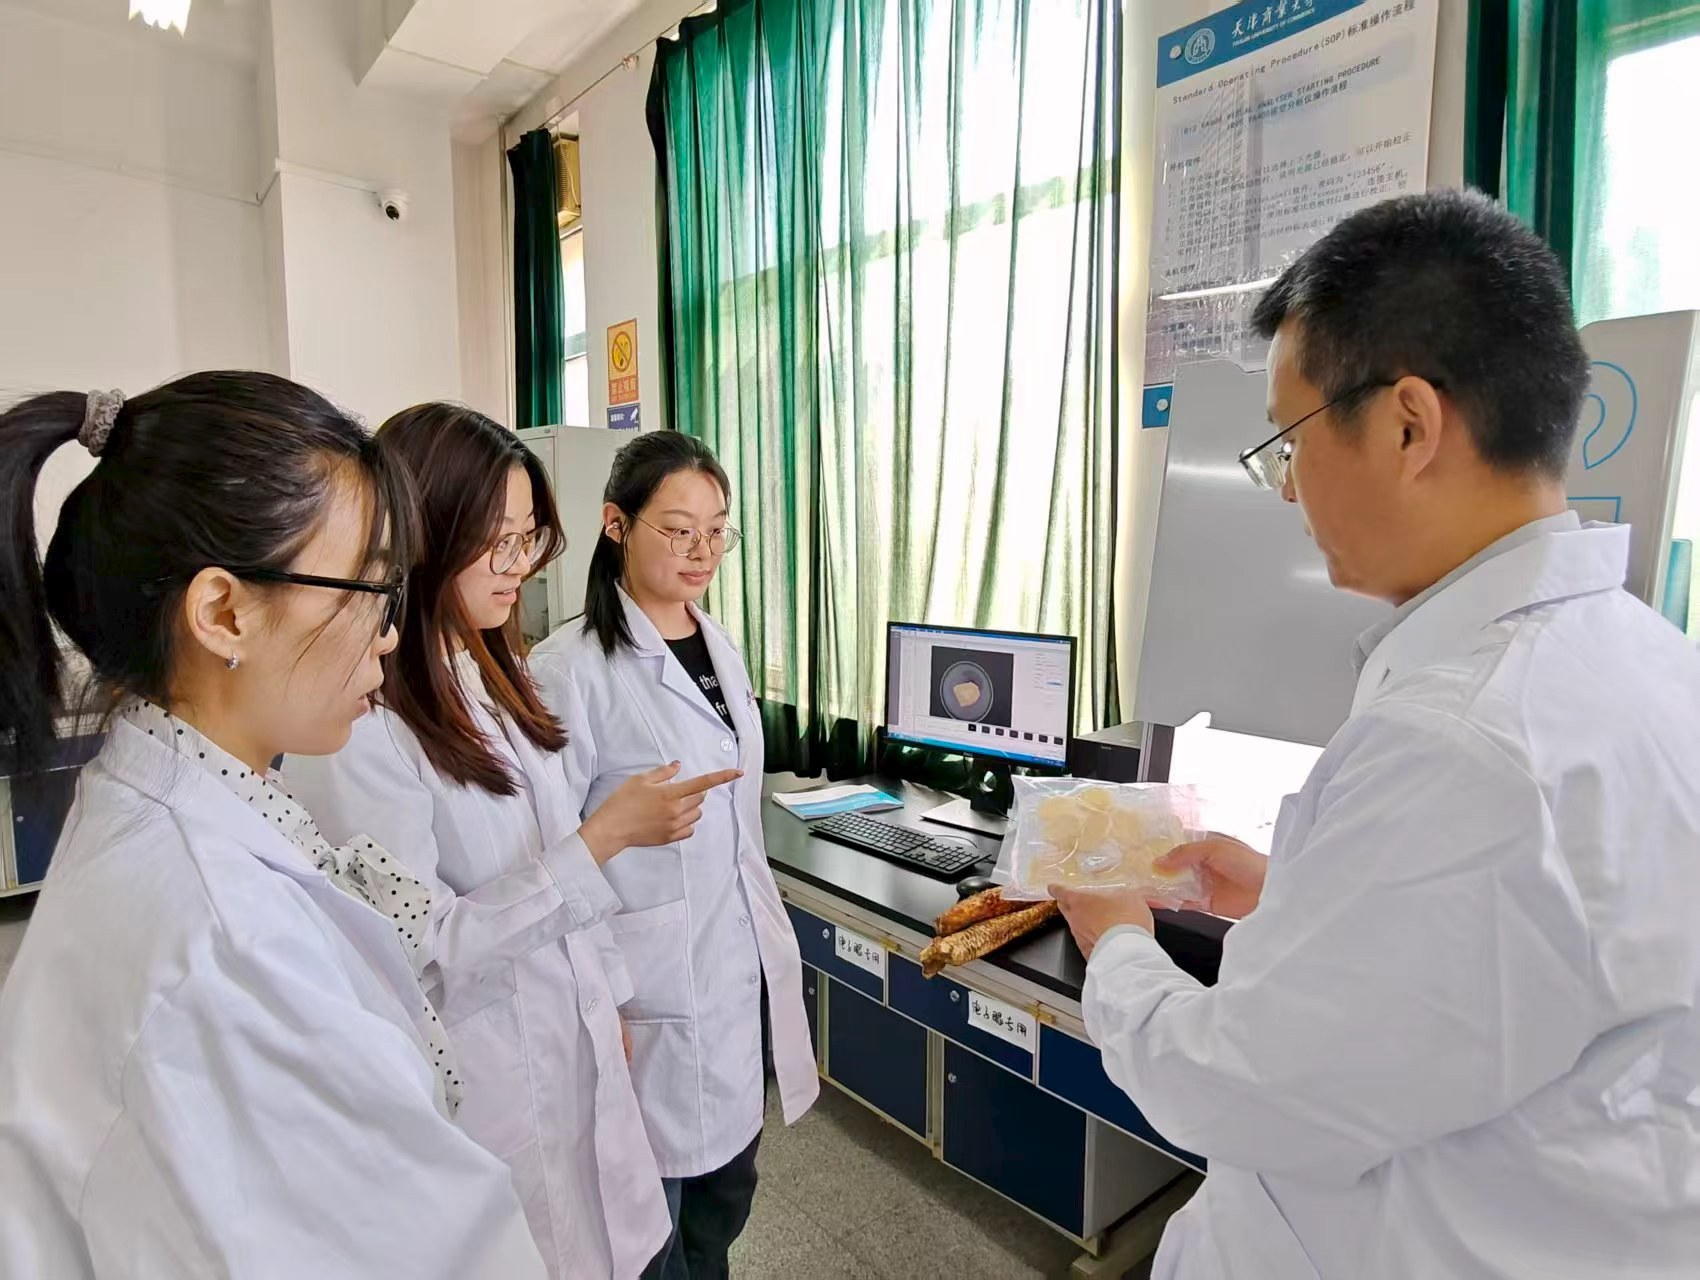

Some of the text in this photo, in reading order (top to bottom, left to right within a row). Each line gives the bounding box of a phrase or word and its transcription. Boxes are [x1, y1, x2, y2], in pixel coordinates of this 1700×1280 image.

[1173, 84, 1213, 105] Standard
[1218, 64, 1266, 89] Operating
[1296, 75, 1334, 96] STARTING
[1337, 55, 1381, 80] PROCEDURE
